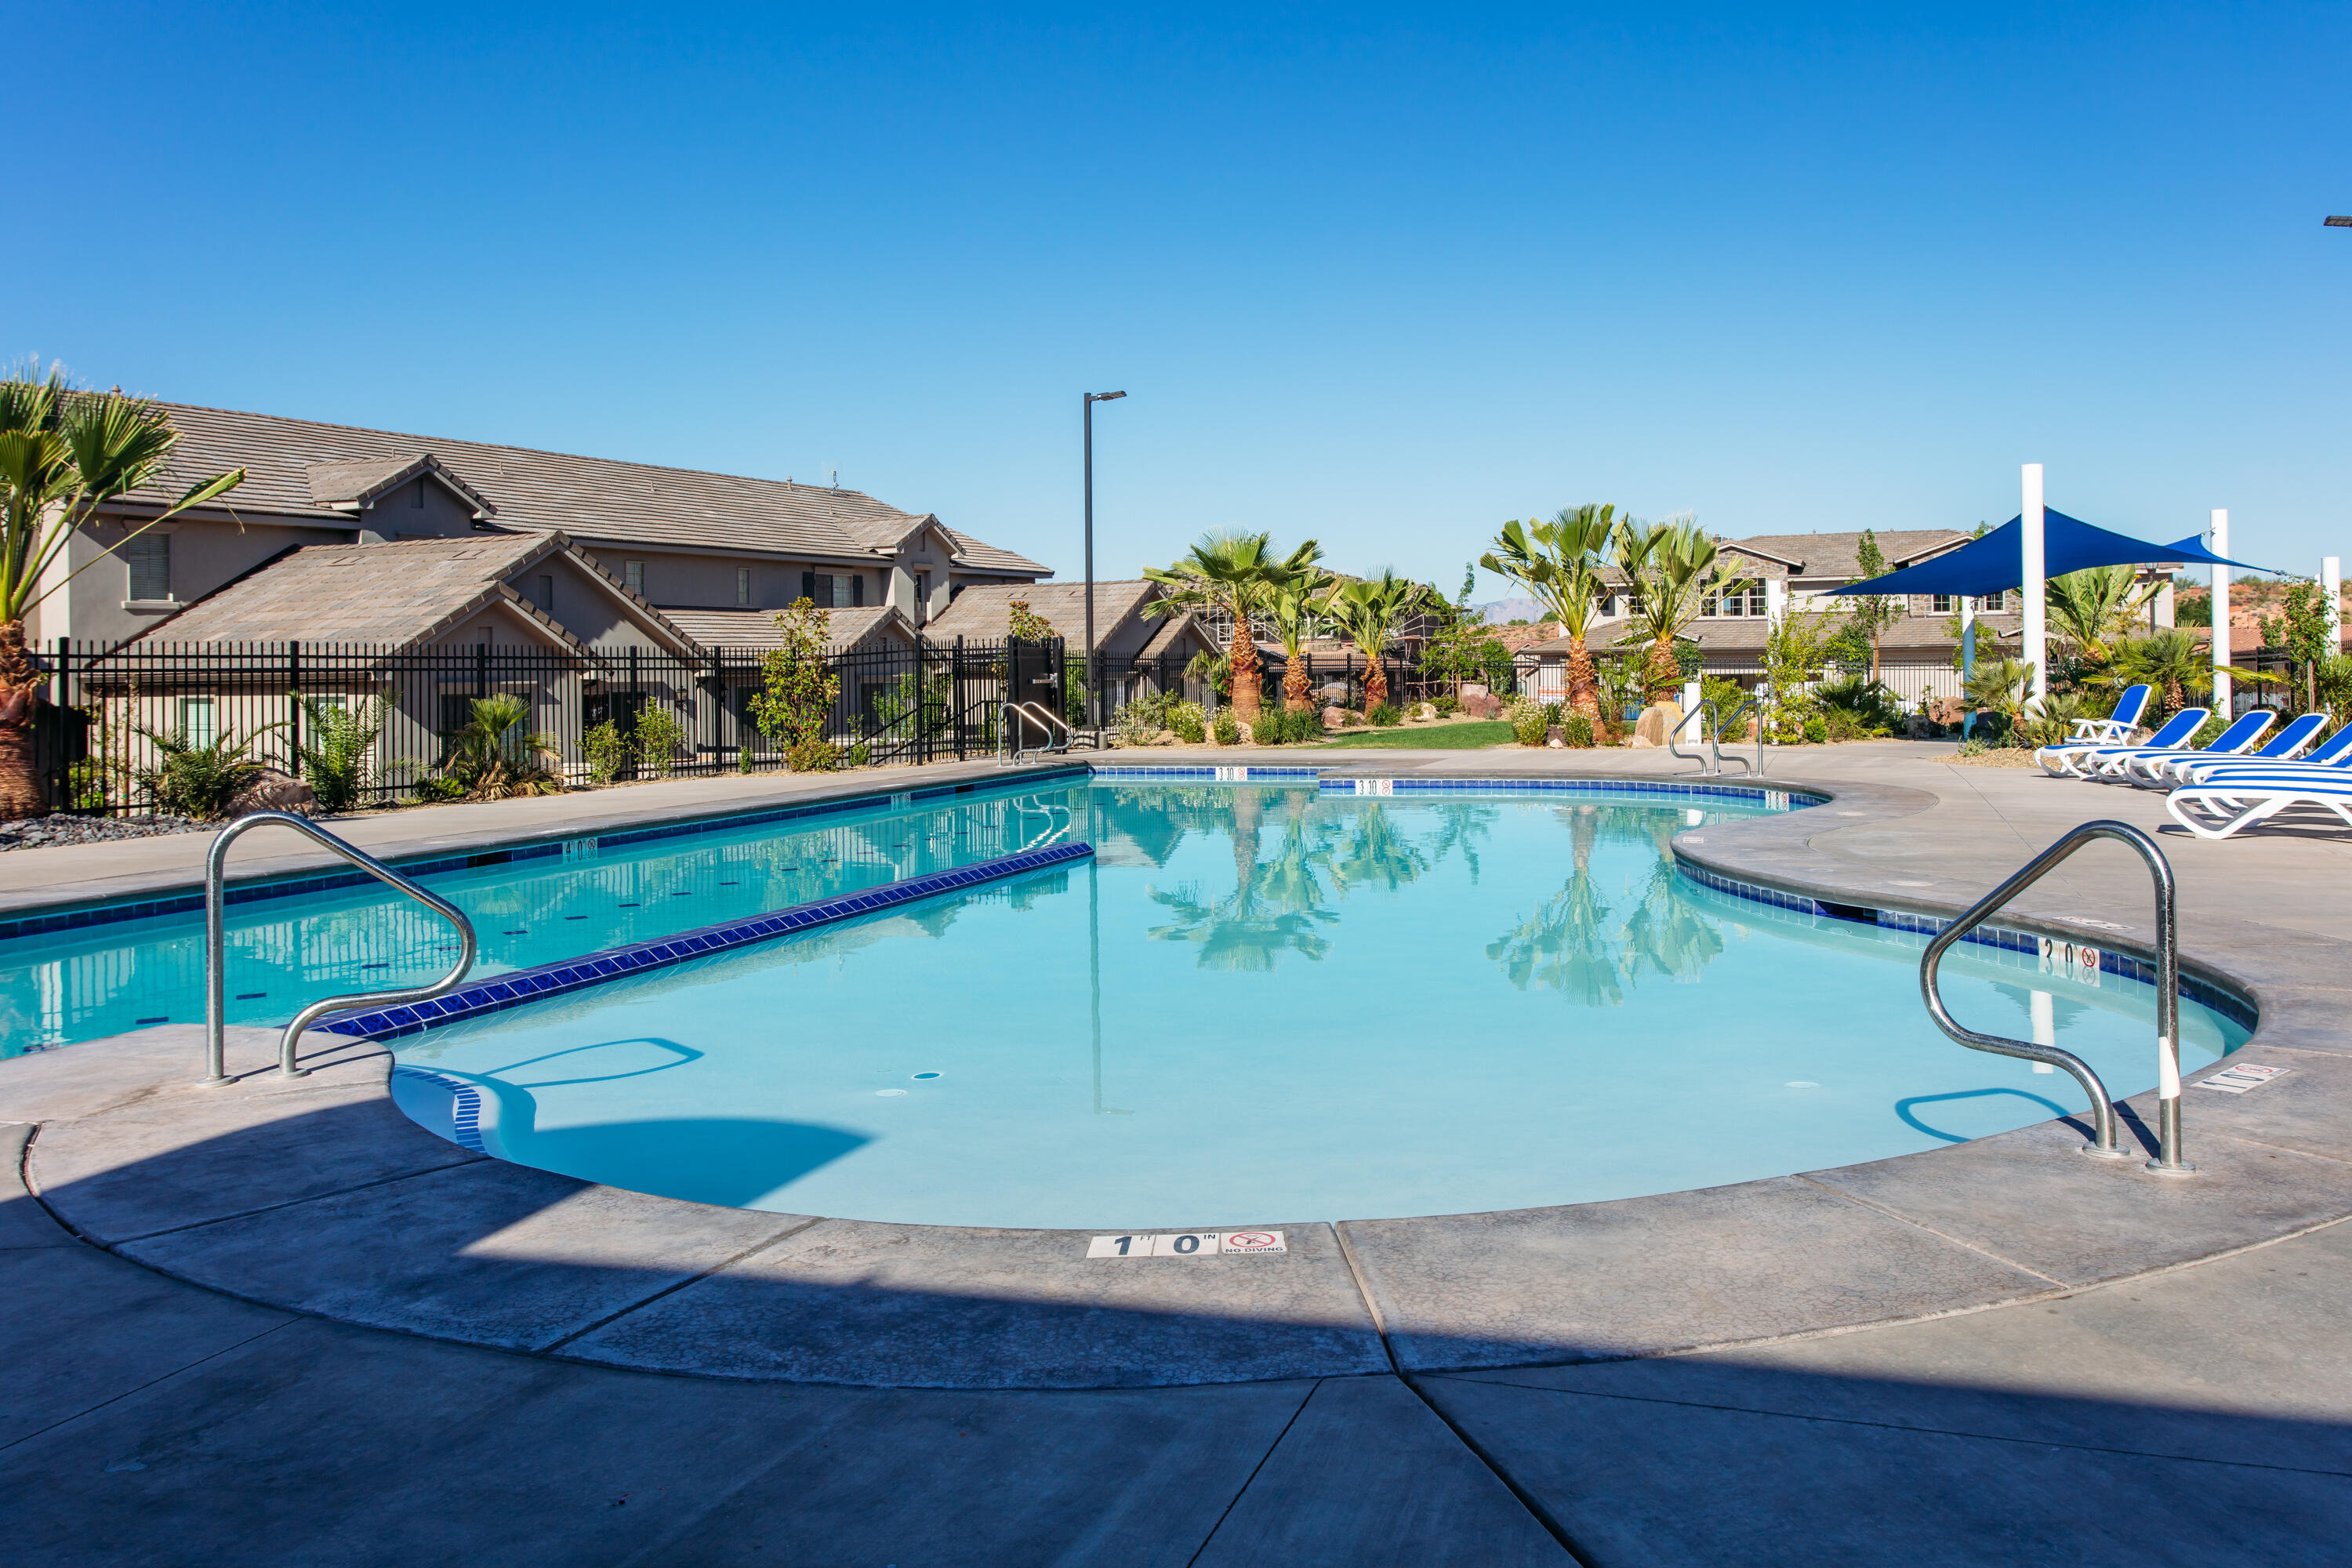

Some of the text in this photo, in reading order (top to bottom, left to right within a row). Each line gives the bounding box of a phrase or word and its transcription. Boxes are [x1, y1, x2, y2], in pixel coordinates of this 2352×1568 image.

[1368, 779, 1377, 795] 10
[566, 840, 572, 853] 4
[2045, 938, 2053, 959] 2
[1114, 1235, 1133, 1256] 1
[1173, 1235, 1200, 1254] 0
